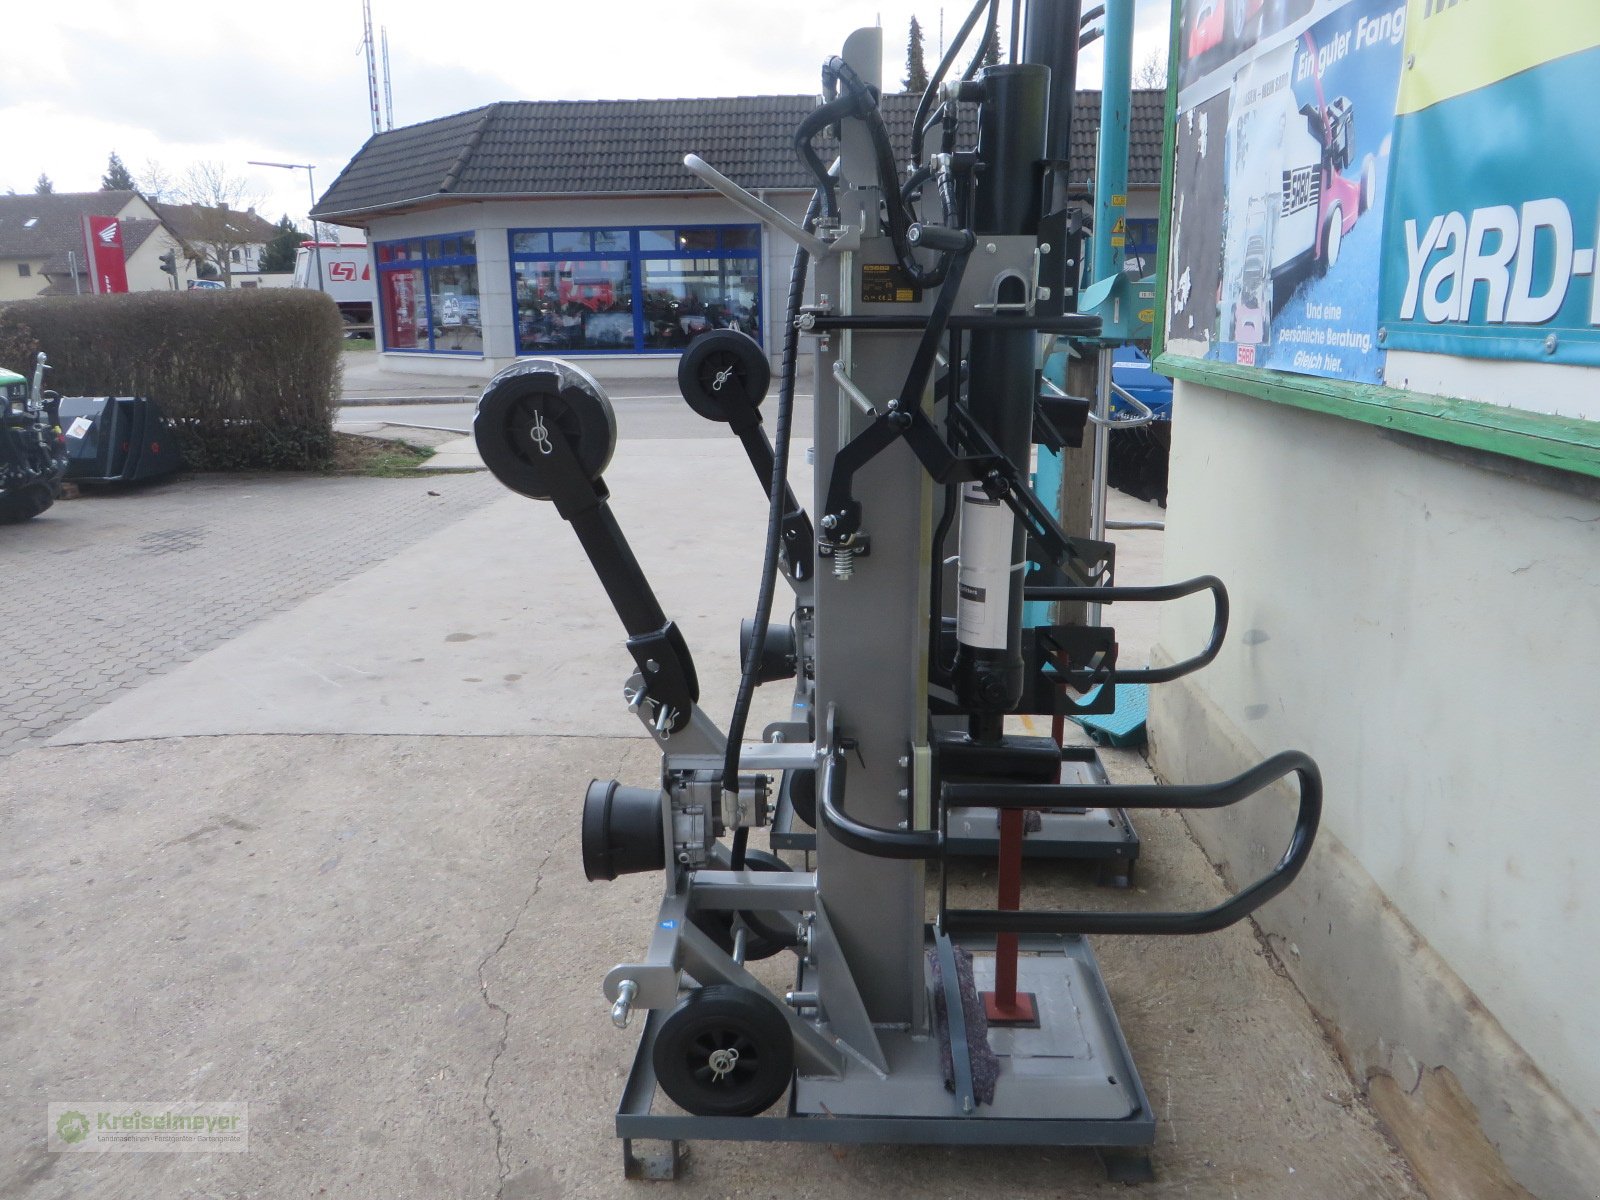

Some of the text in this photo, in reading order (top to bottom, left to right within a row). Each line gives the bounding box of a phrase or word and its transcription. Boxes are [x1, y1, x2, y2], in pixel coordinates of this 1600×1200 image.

[1297, 51, 1315, 82] Ein
[1317, 28, 1353, 80] guter
[1355, 4, 1407, 51] Fang
[1399, 197, 1600, 327] YaRD-
[1306, 302, 1342, 320] Und eine
[1278, 324, 1372, 354] persönliche Beratung.
[1237, 346, 1256, 366] SABO
[1293, 349, 1343, 373] Gleich hier.
